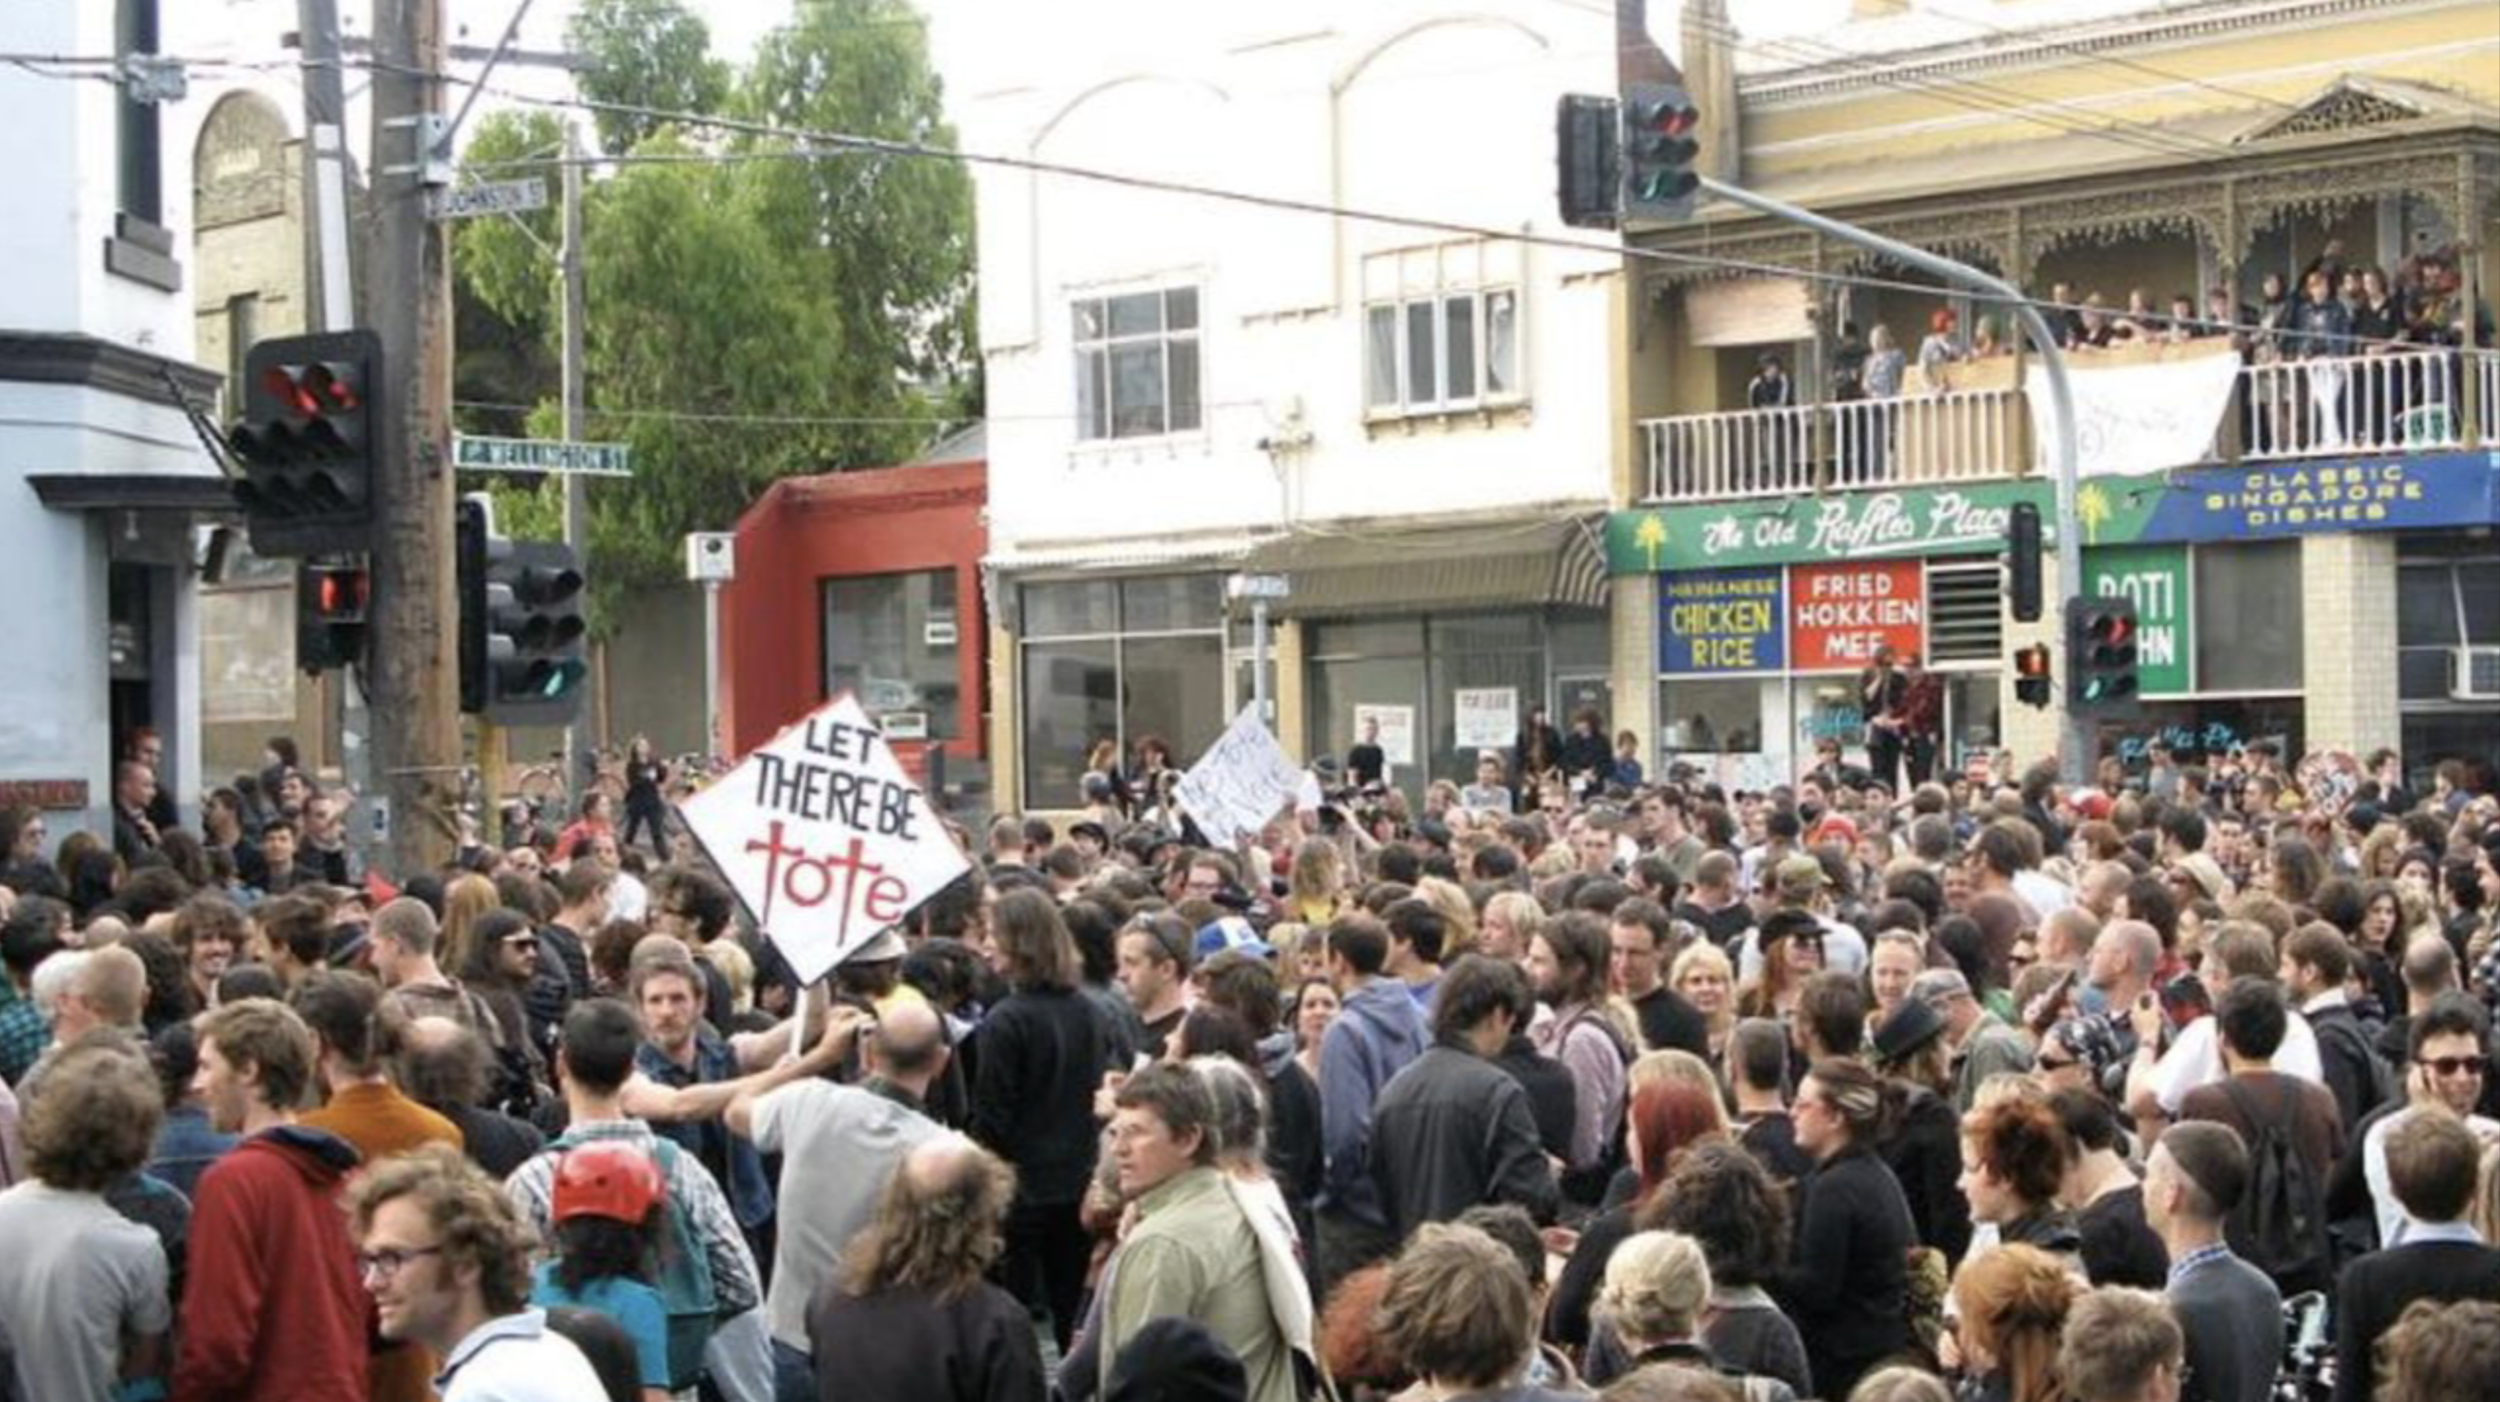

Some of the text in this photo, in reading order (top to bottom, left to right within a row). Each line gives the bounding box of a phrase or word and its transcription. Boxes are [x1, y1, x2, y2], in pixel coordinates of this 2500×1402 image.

[446, 184, 523, 213] JOHNSTON
[488, 442, 629, 472] WELLINGTON ST
[2246, 465, 2402, 489] CLASSIC
[2206, 481, 2422, 510] SINGAPORE
[1702, 491, 2013, 555] The Old Raffles Plac
[2248, 503, 2386, 526] DISHES
[1812, 573, 1893, 598] FRIED
[1671, 600, 1771, 635] CHICKEN
[1797, 600, 1920, 629] HOKKIEN
[1692, 637, 1757, 668] RICE
[805, 718, 880, 765] LET
